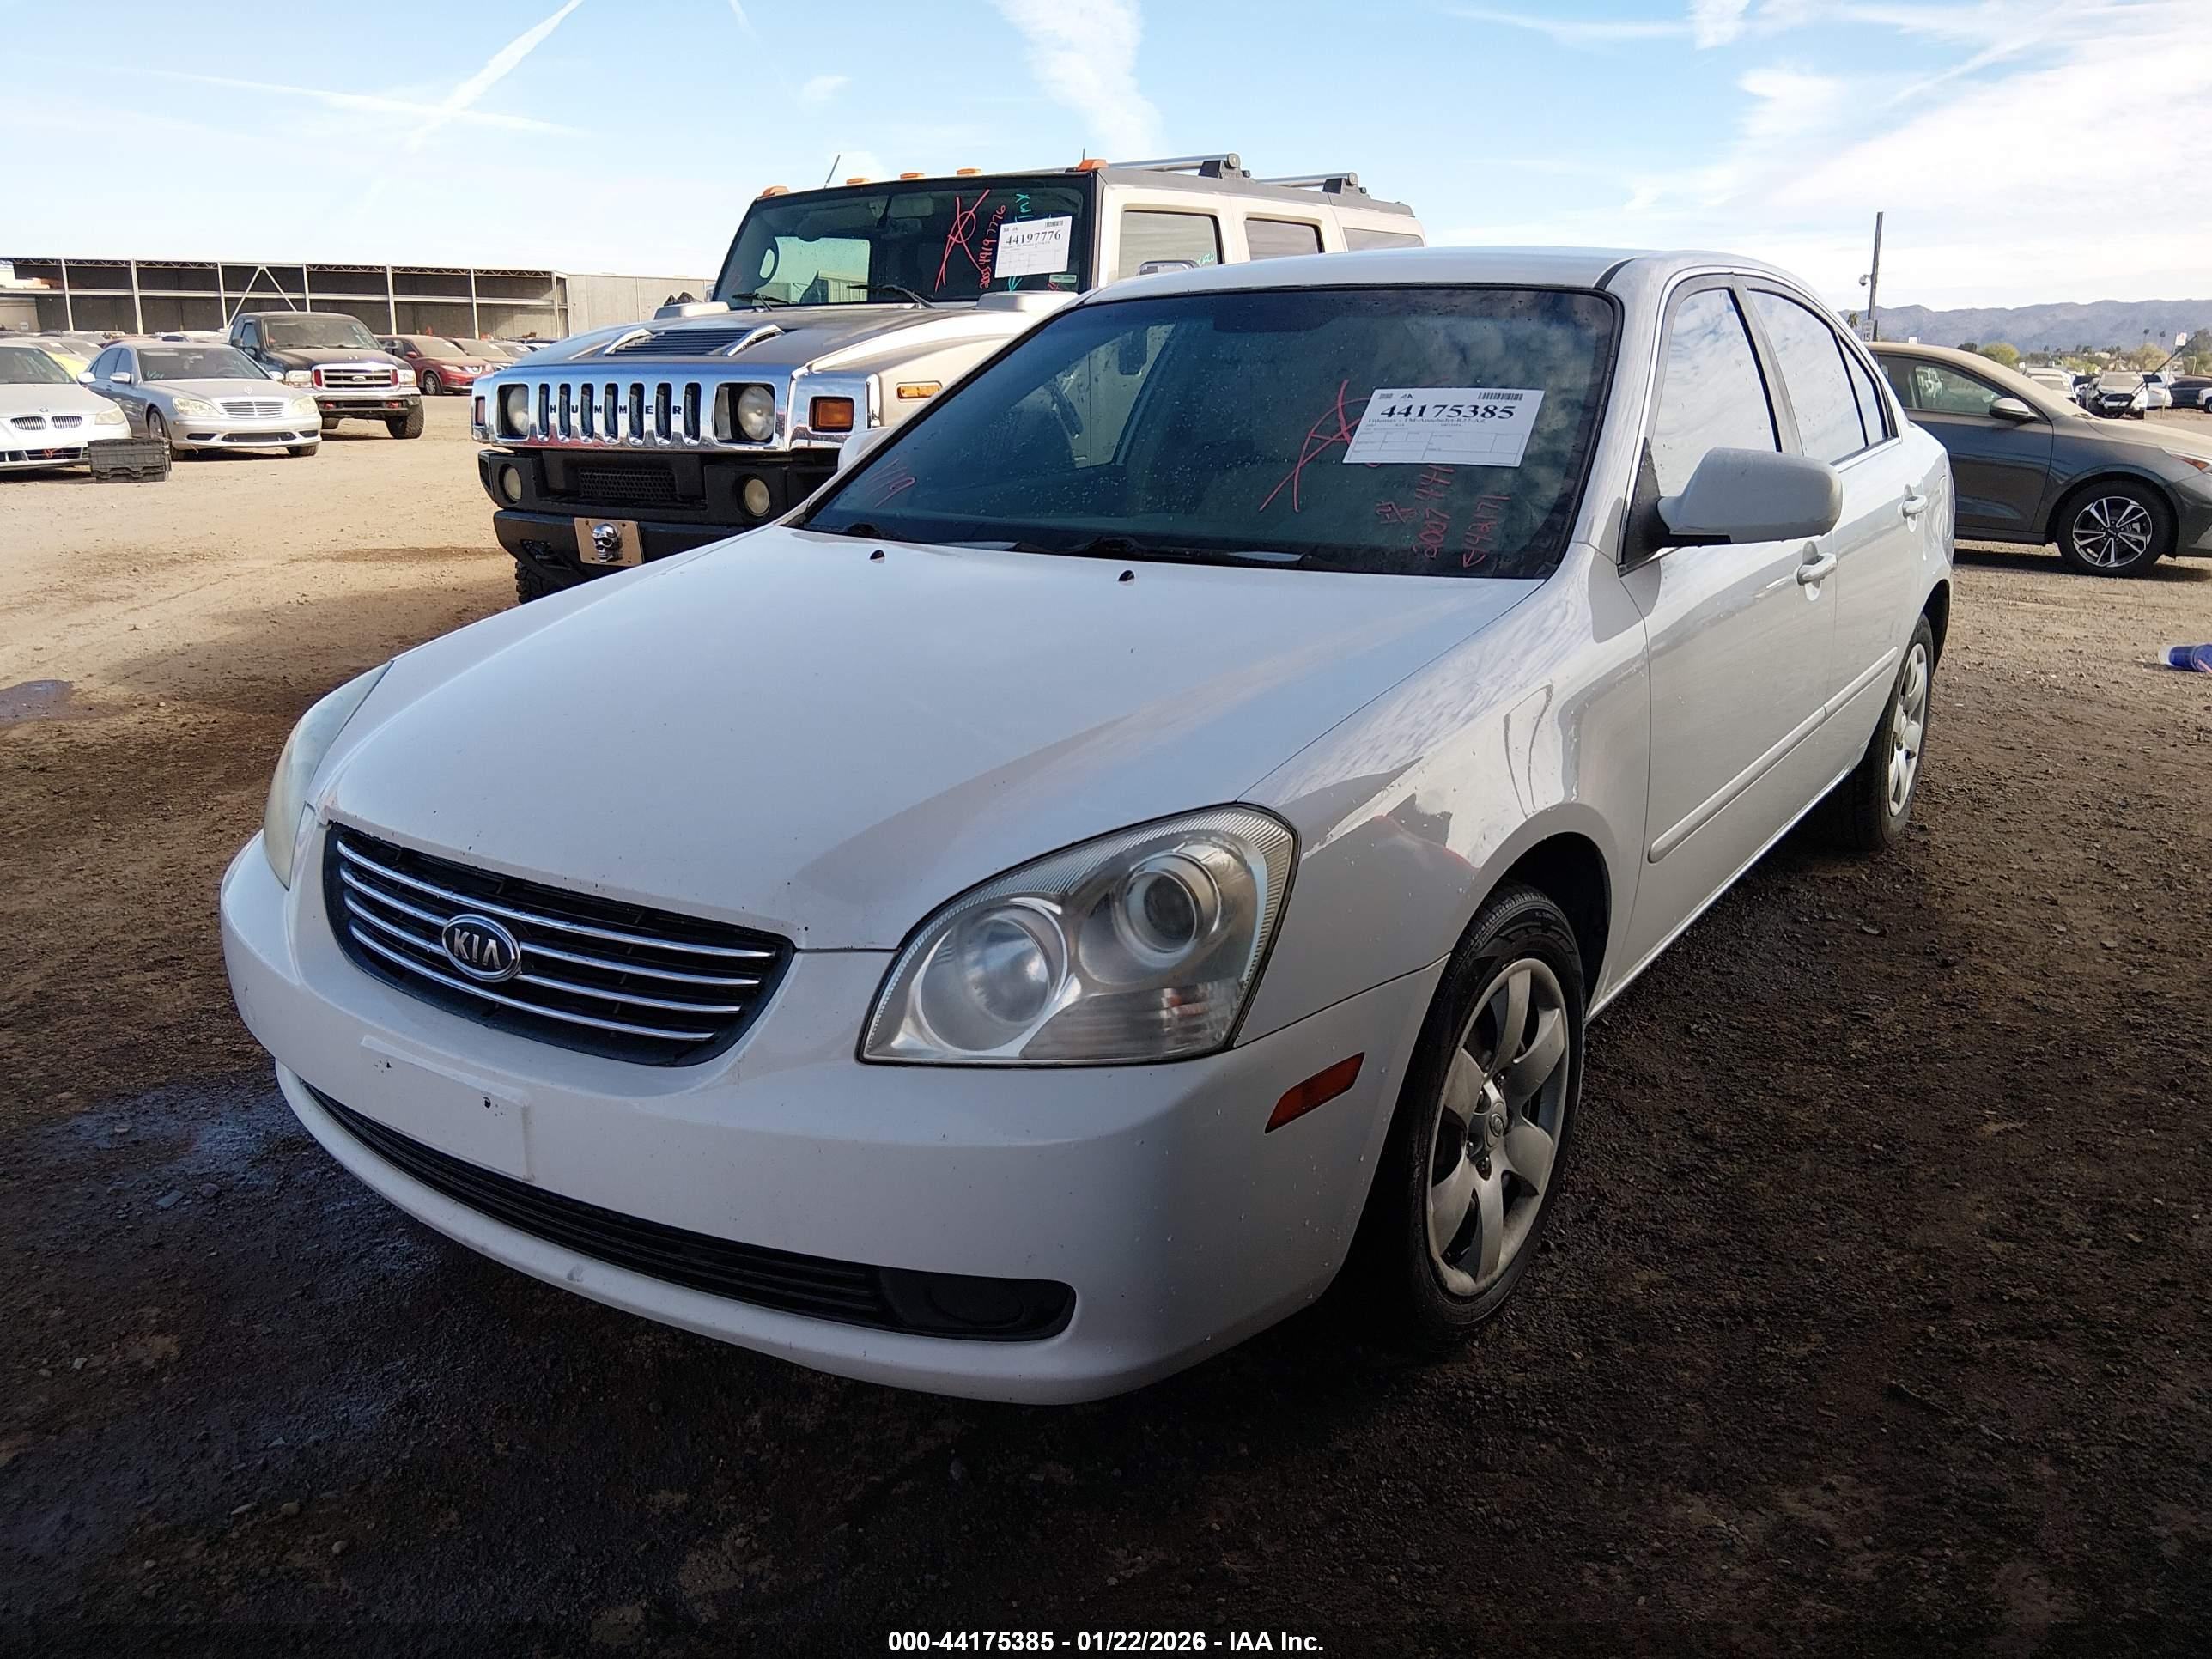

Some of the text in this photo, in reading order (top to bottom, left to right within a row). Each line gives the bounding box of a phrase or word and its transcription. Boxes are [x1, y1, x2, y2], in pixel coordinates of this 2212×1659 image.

[1006, 230, 1061, 246] 44197776
[550, 404, 683, 416] HUMMER
[1380, 404, 1516, 420] 44175385
[453, 928, 501, 969] KIA
